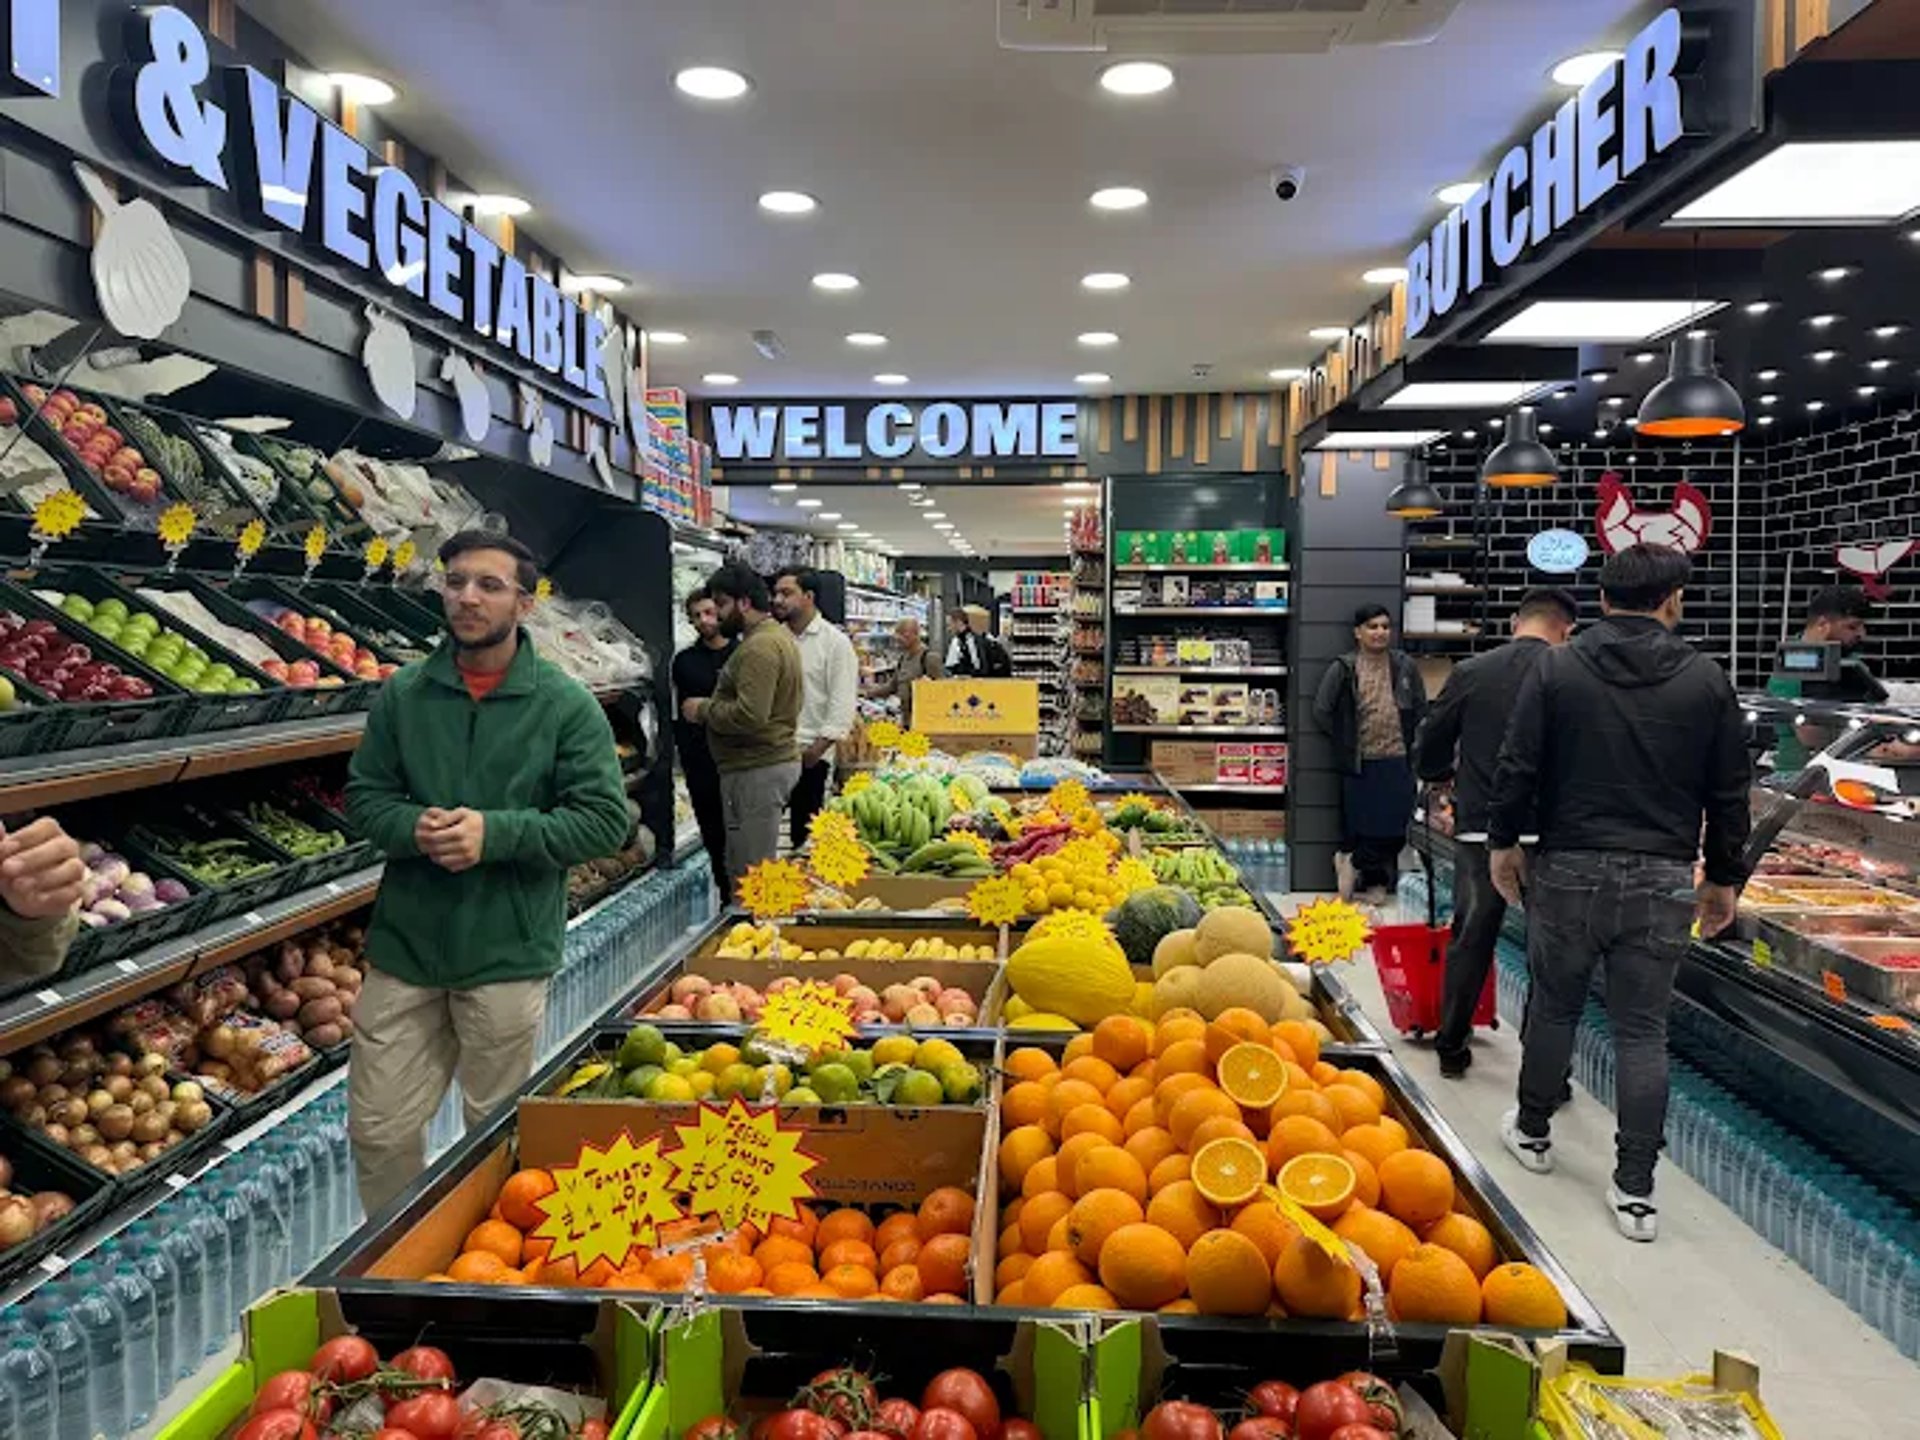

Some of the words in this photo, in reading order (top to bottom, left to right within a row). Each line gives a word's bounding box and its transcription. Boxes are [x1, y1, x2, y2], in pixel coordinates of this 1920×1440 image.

[134, 5, 230, 192] &
[1406, 7, 1684, 340] BUTCHER
[710, 402, 1080, 460] WELCOME
[584, 1162, 652, 1190] TOMATO
